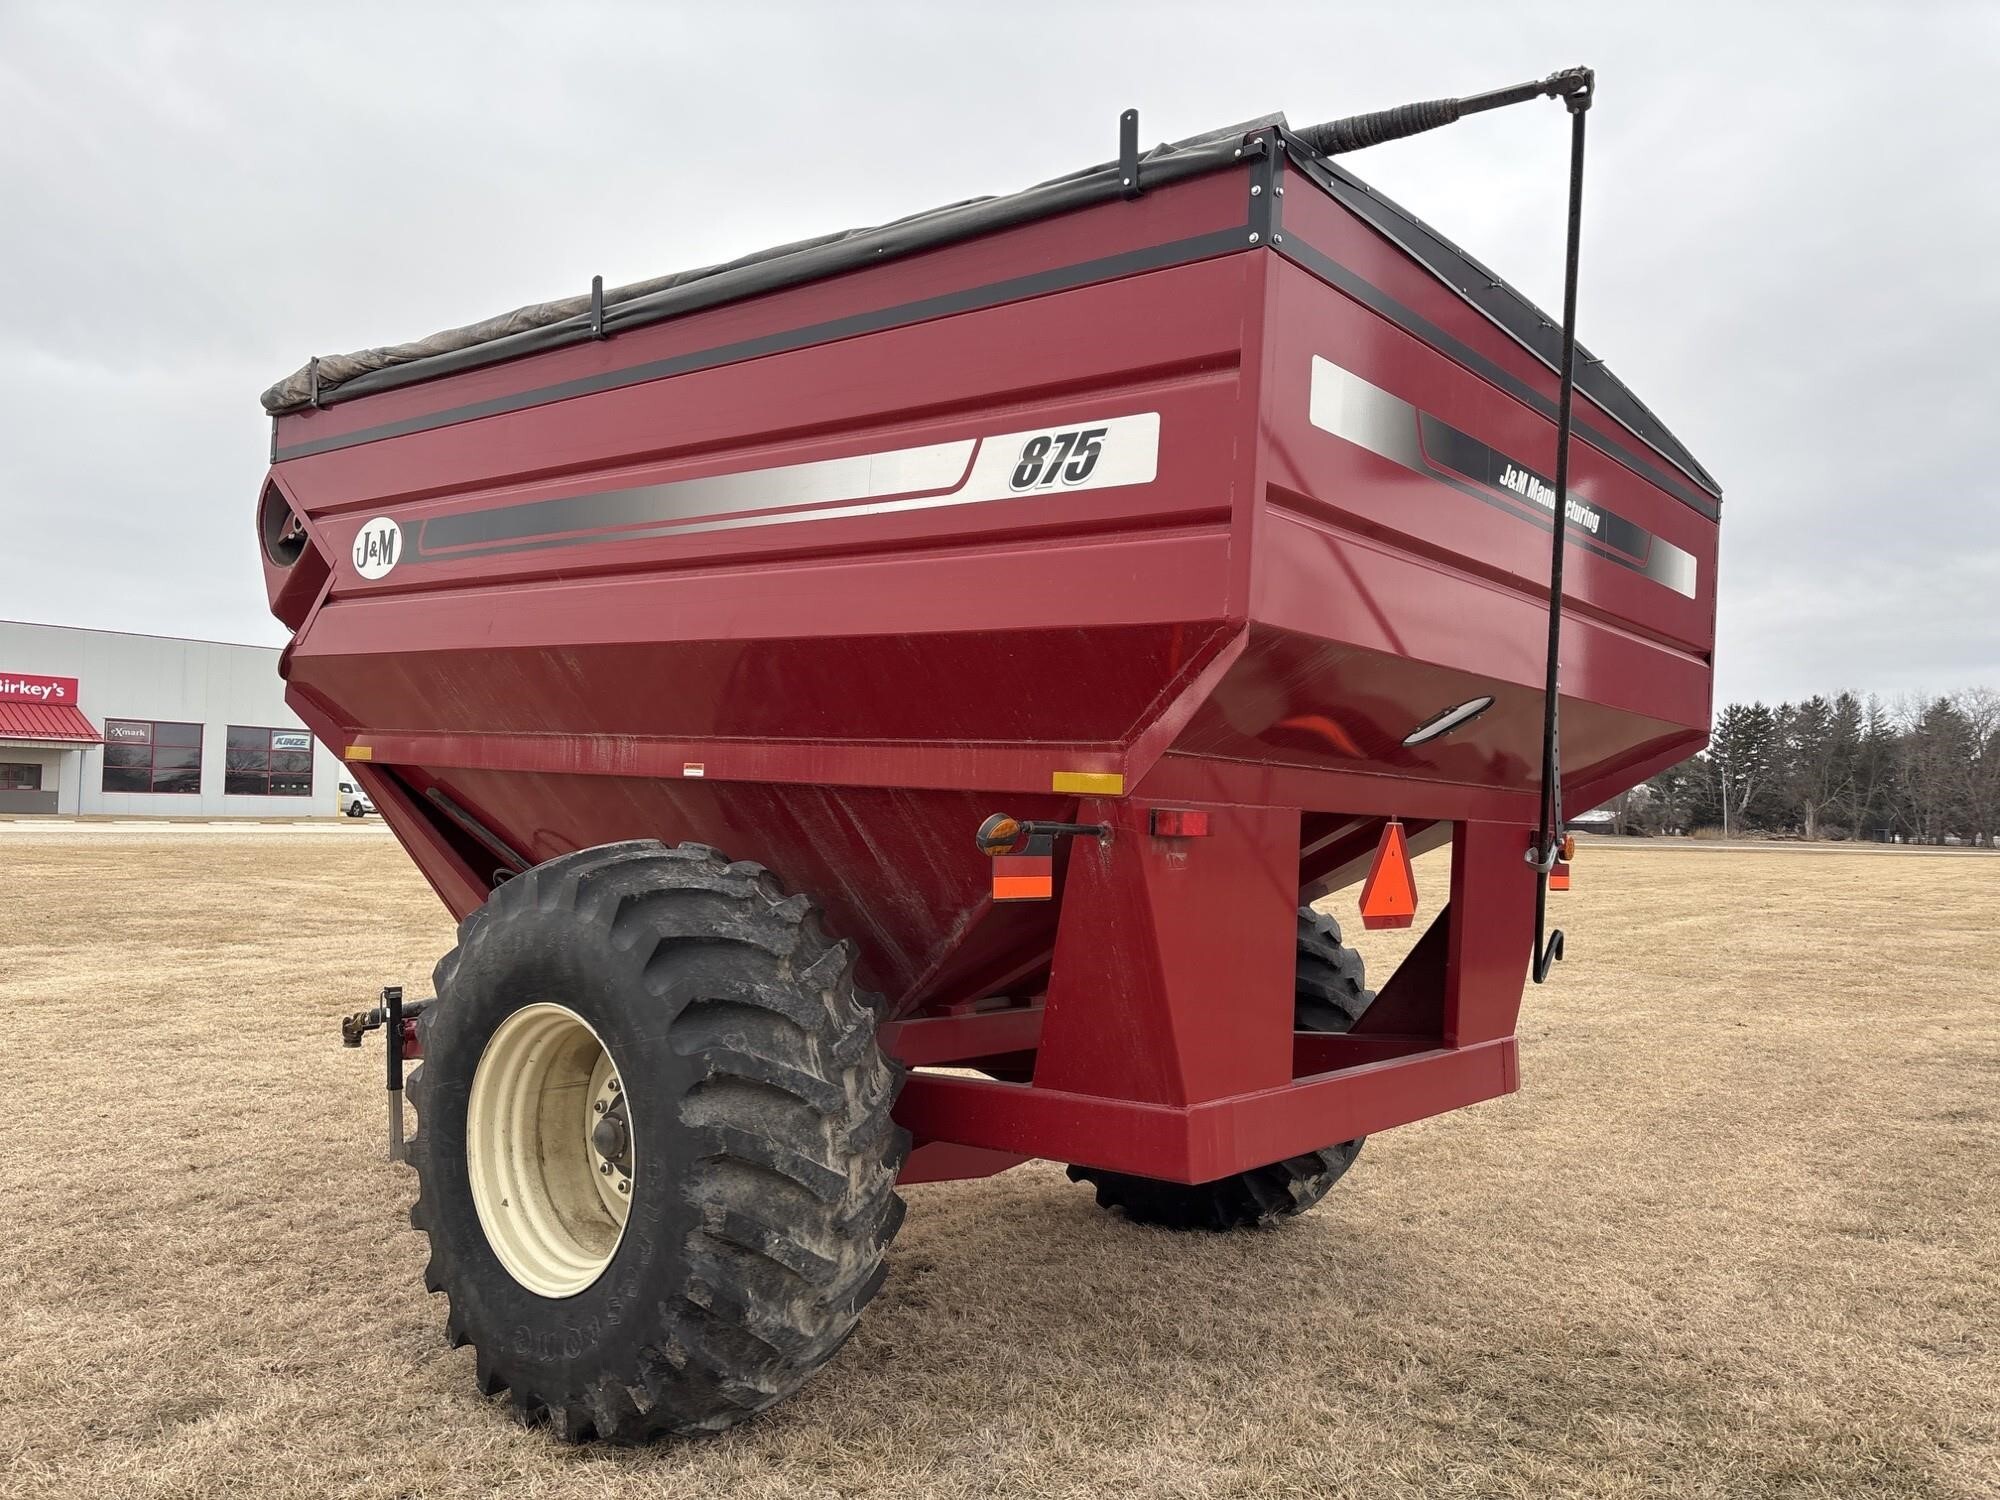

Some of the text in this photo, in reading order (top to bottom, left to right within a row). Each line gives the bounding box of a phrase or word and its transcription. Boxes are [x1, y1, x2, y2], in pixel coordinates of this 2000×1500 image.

[1010, 427, 1110, 490] 875
[1499, 464, 1600, 533] J&M Manucturing
[356, 528, 396, 568] J&M
[110, 727, 146, 737] eXmark
[275, 737, 308, 746] KINZE
